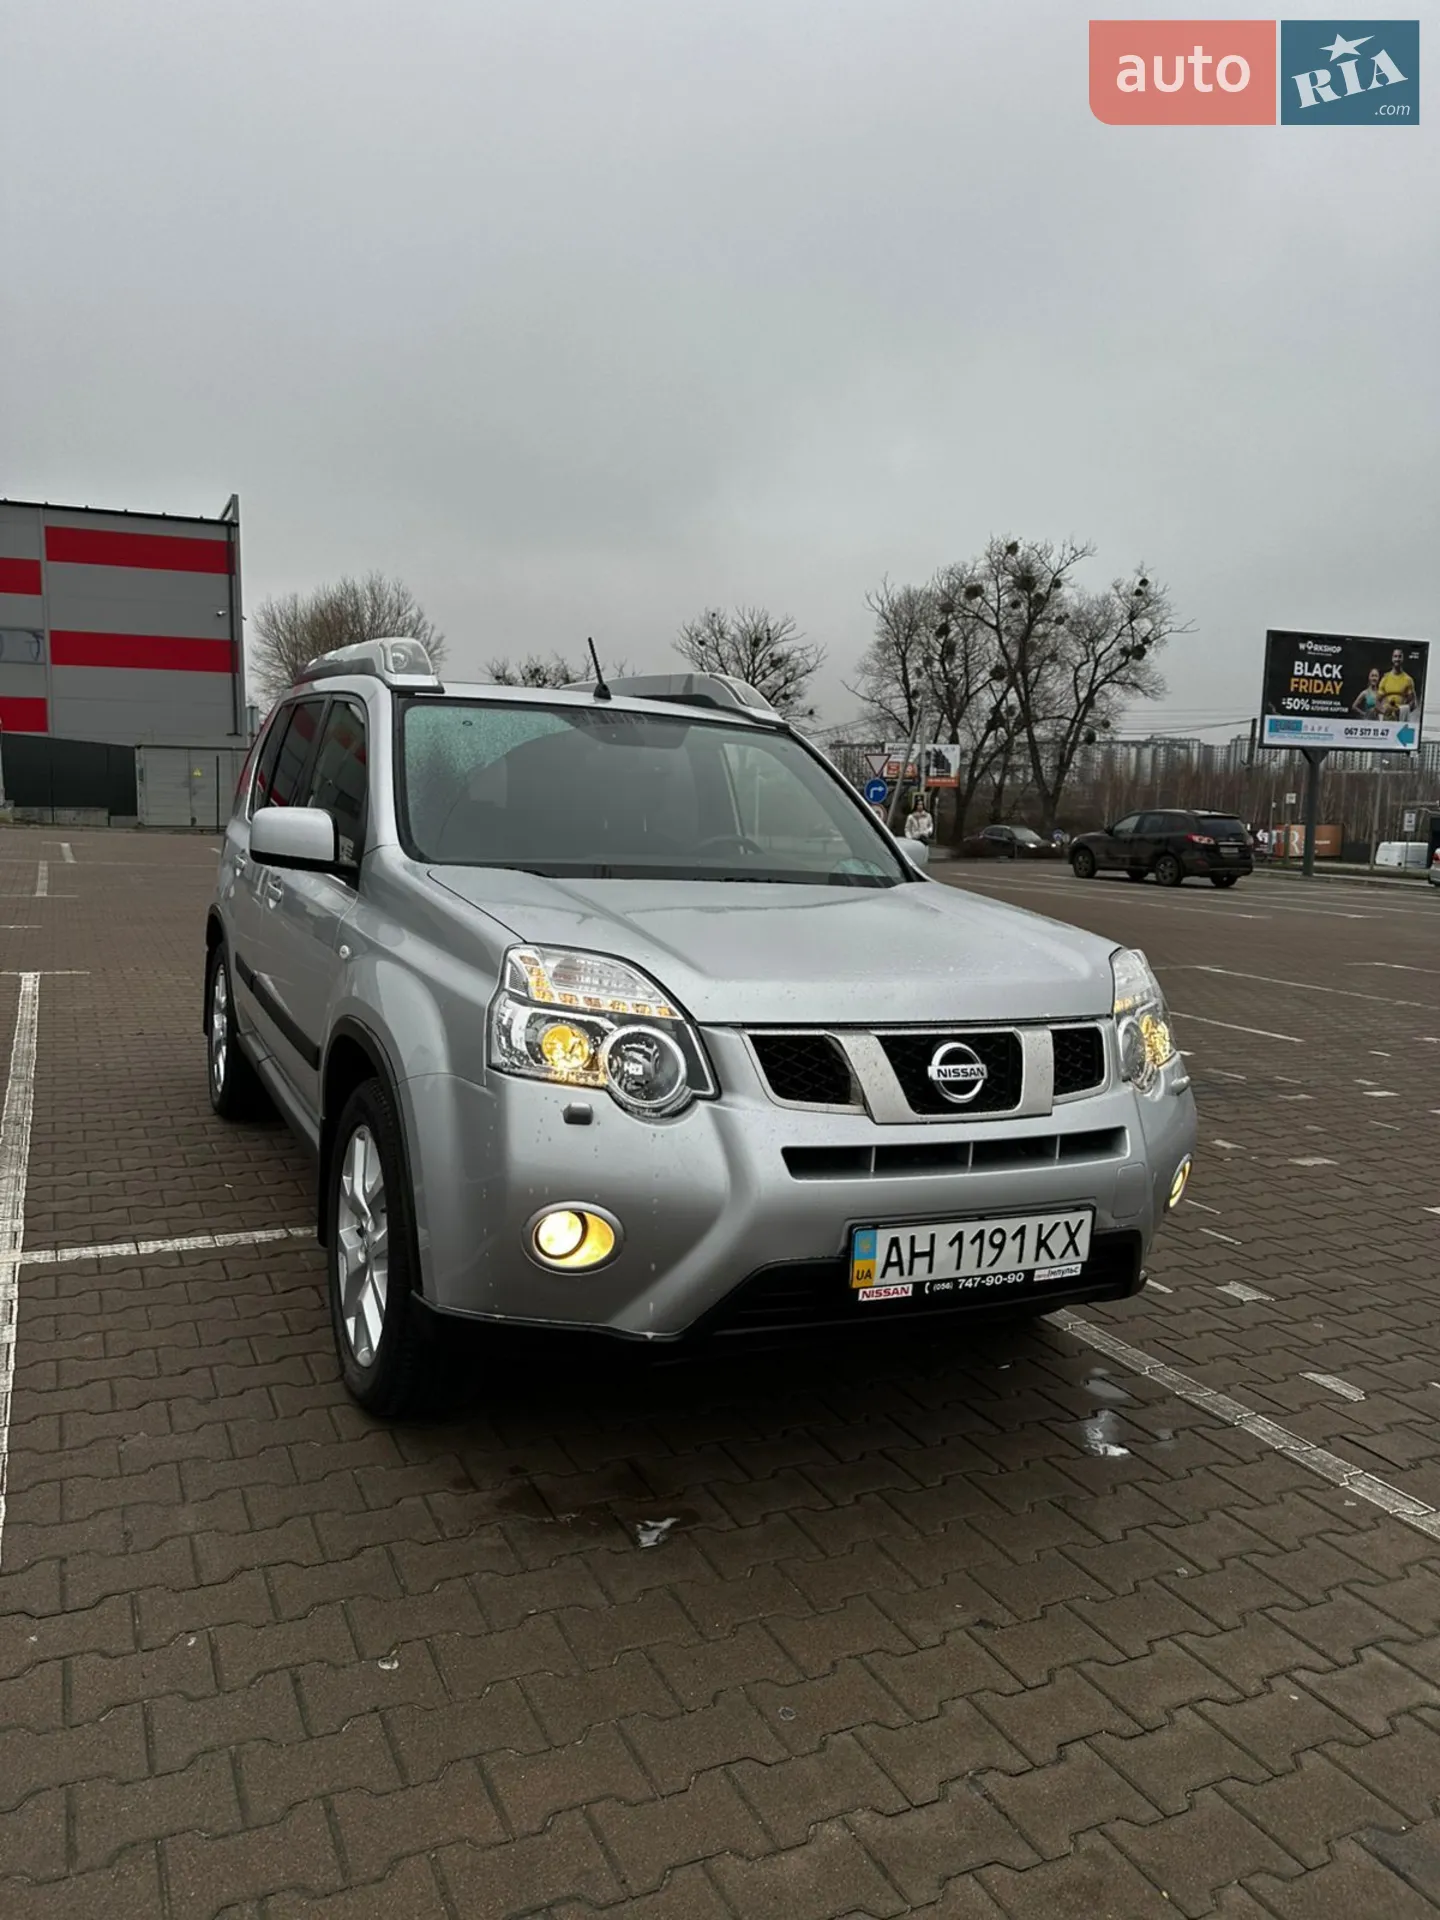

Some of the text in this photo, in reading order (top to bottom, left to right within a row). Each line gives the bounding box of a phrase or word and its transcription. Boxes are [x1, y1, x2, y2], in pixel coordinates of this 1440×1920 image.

[1299, 640, 1342, 654] WORKSHOP
[1293, 661, 1343, 679] BLACK
[1290, 677, 1343, 695] FRIDAY
[1344, 727, 1358, 736] 067
[1380, 728, 1390, 737] 47
[937, 1067, 984, 1078] NISSAN
[880, 1219, 1085, 1279] AH 1191 KX
[856, 1271, 872, 1281] UA
[957, 1272, 1025, 1289] 747-90-90
[861, 1286, 910, 1300] NISSAN
